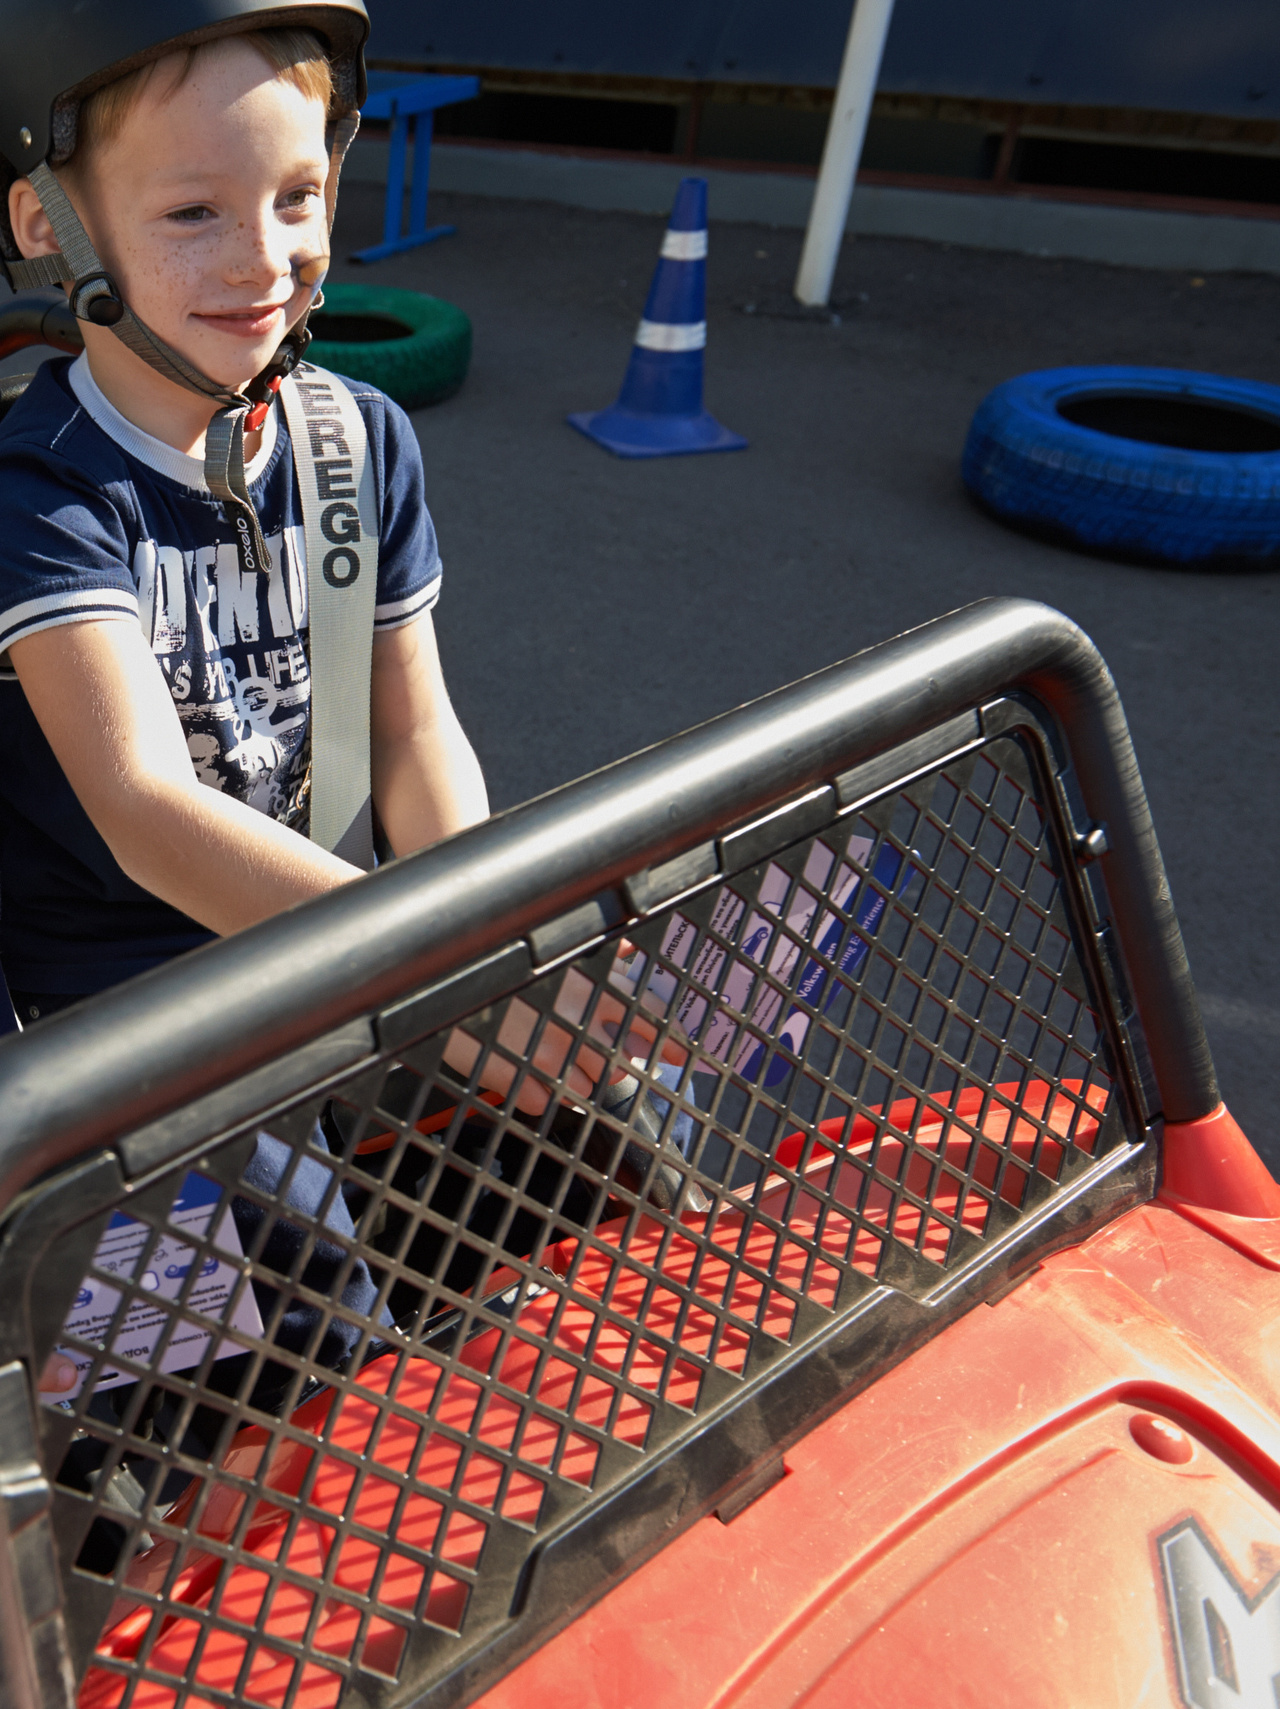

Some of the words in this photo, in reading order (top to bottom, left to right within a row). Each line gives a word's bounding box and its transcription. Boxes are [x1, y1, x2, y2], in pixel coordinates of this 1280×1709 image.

[236, 516, 256, 569] oxelo
[683, 972, 710, 1011] Volksgen
[795, 938, 839, 1002] Volkswgen
